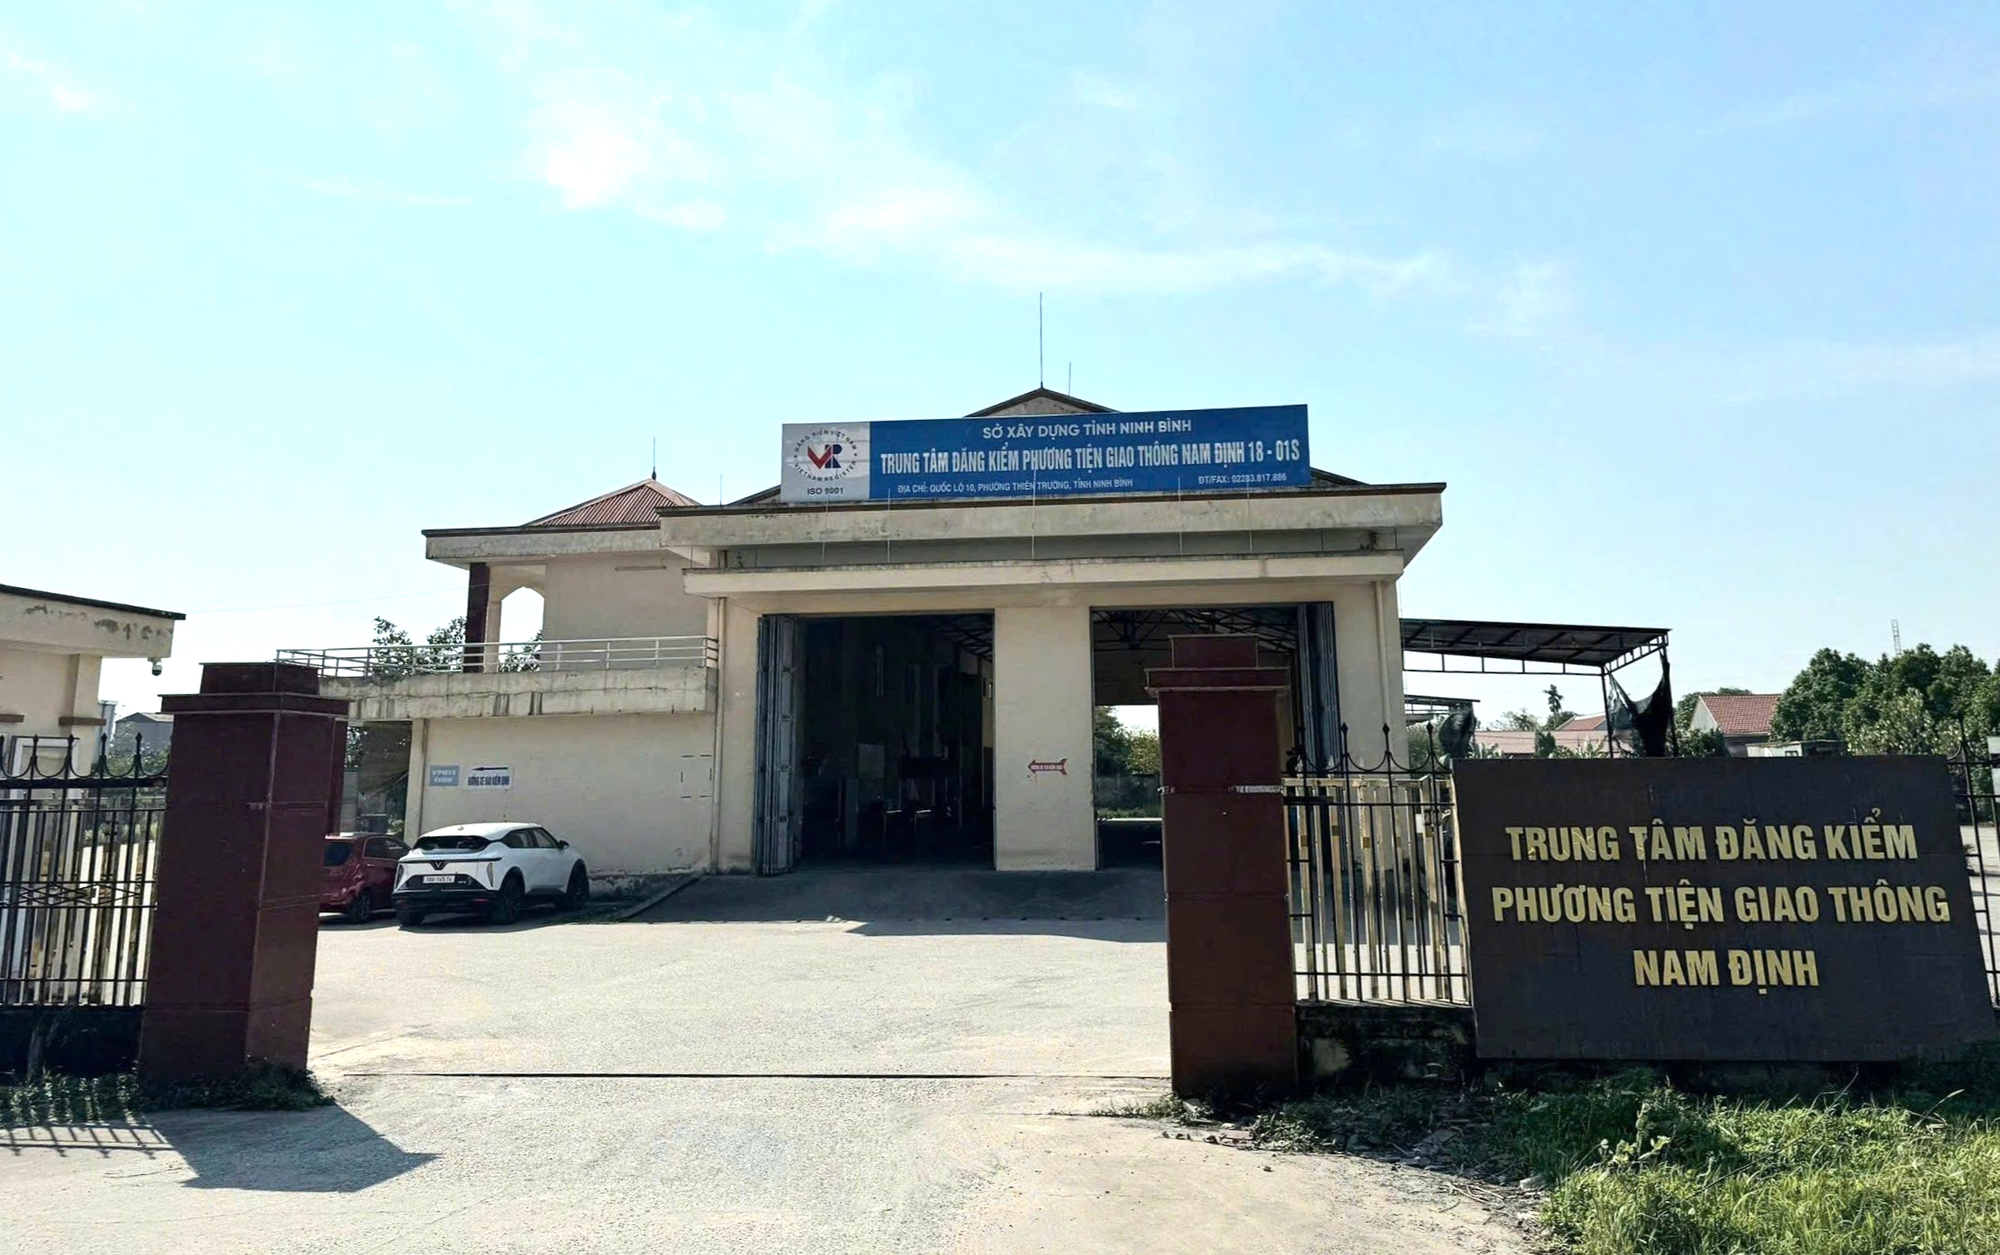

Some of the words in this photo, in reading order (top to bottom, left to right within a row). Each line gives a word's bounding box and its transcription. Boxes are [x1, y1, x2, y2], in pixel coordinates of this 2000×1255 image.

[983, 423, 1003, 439] SỞ
[1007, 423, 1034, 438] XÂY
[1038, 423, 1080, 440] DỰNG
[1084, 419, 1116, 436] TỈNH
[1120, 420, 1154, 434] NINH
[1158, 417, 1192, 433] BÌNH
[880, 452, 920, 474] TRUNG
[923, 448, 949, 474] TÂM
[952, 447, 985, 473] ĐĂNG
[988, 441, 1019, 472] KIỂM
[1023, 446, 1072, 471] PHƯƠNG
[1075, 443, 1103, 473] TIỆN
[1106, 445, 1134, 468] GIAO
[1137, 440, 1179, 467] THÔNG
[1182, 443, 1211, 465] NAM
[1214, 440, 1245, 468] ĐỊNH
[1248, 440, 1264, 462] 18
[1275, 438, 1300, 462] 01S
[794, 462, 823, 482] VIETNAM
[824, 460, 857, 482] REGISTER
[1198, 474, 1230, 485] ĐT/FAX:
[807, 487, 823, 495] ISO
[824, 486, 844, 495] 9001
[897, 485, 911, 495] ĐỊA
[929, 480, 952, 493] QUỐC
[953, 481, 965, 494] LỘ
[966, 483, 976, 493] 10,
[1093, 479, 1112, 488] NINH
[1114, 477, 1133, 487] BÌNH
[1505, 825, 1620, 862] TRUNG
[1628, 818, 1707, 861] TÂM
[1714, 817, 1818, 861] ĐĂNG
[1823, 807, 1918, 860] KIỂM
[1491, 882, 1637, 923] PHƯƠNG
[1644, 878, 1725, 930] TIỆN
[1734, 885, 1820, 923] GIAO
[1827, 878, 1951, 923] THÔNG
[1633, 948, 1720, 986] NAM
[1727, 948, 1820, 995] ĐỊNH
